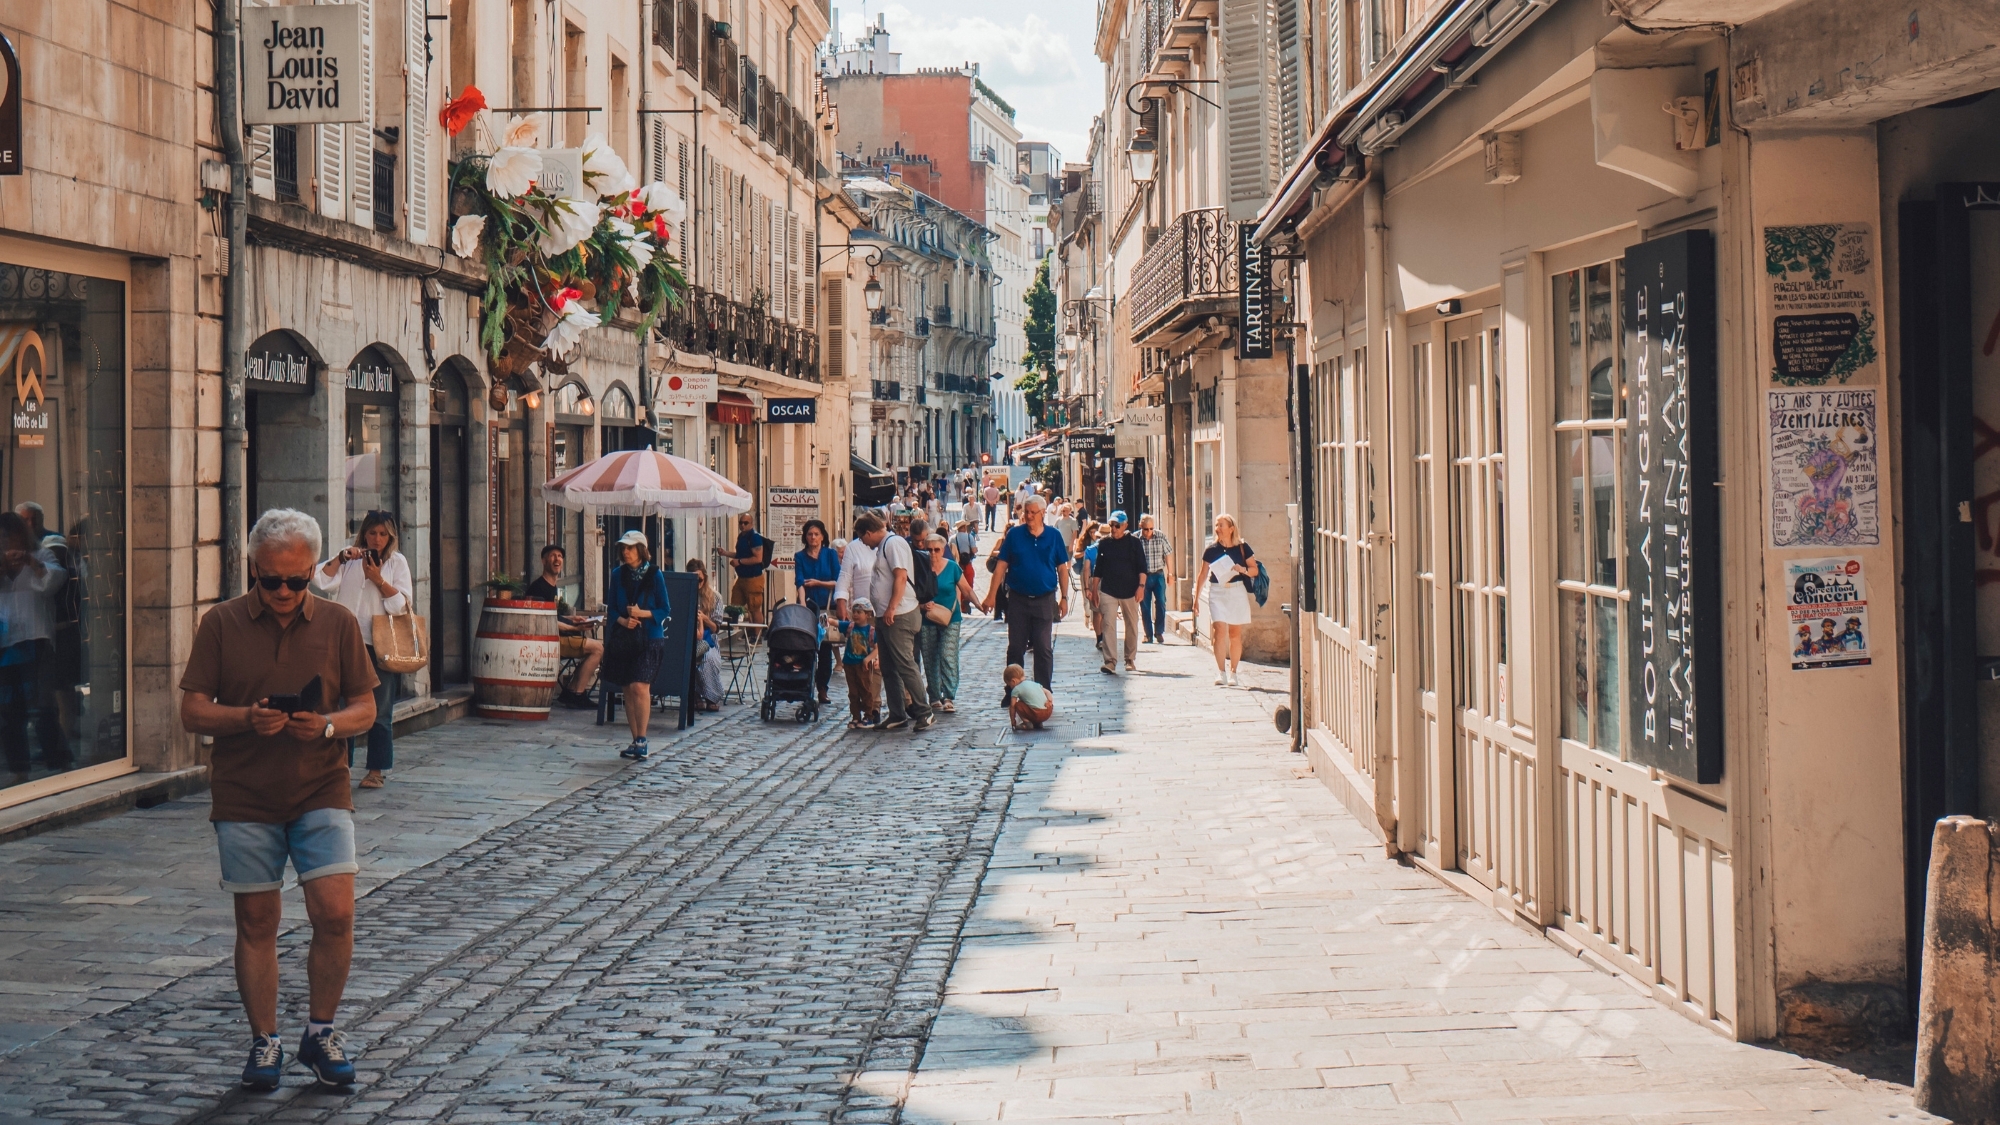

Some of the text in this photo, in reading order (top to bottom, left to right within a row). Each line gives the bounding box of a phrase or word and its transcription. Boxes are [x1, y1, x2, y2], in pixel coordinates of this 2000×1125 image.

[263, 20, 324, 50] Jean
[267, 50, 339, 80] Louis
[267, 79, 340, 110] David
[1264, 285, 1270, 297] LA
[1773, 280, 1844, 293] RASSEMBLEMENT
[1773, 293, 1788, 302] POUR
[1789, 293, 1798, 301] LES
[1808, 292, 1819, 300] ANS
[1820, 292, 1831, 300] DES
[1264, 303, 1270, 315] DE
[244, 349, 308, 385] Jean Louis David
[1788, 365, 1801, 373] UNE
[357, 363, 374, 391] Louis
[375, 365, 393, 393] David
[686, 383, 708, 391] Japon
[26, 400, 37, 412] Les
[1774, 392, 1872, 409] 15 ANS DE LUTTES
[771, 405, 810, 416] OSCAR
[13, 411, 30, 429] toits
[30, 417, 38, 429] de
[1126, 412, 1163, 423] MuiMa
[1779, 409, 1865, 429] LENTILLÈRES
[1070, 436, 1096, 444] SIMONE
[1860, 463, 1872, 472] MAI
[1845, 475, 1854, 484] AU
[1861, 474, 1875, 483] JUIN
[772, 493, 817, 504] OSAKA
[1637, 284, 1656, 744] BOULANGERIE
[1676, 290, 1695, 750] TRAITEUR-SNACKING
[1792, 588, 1859, 605] Concert
